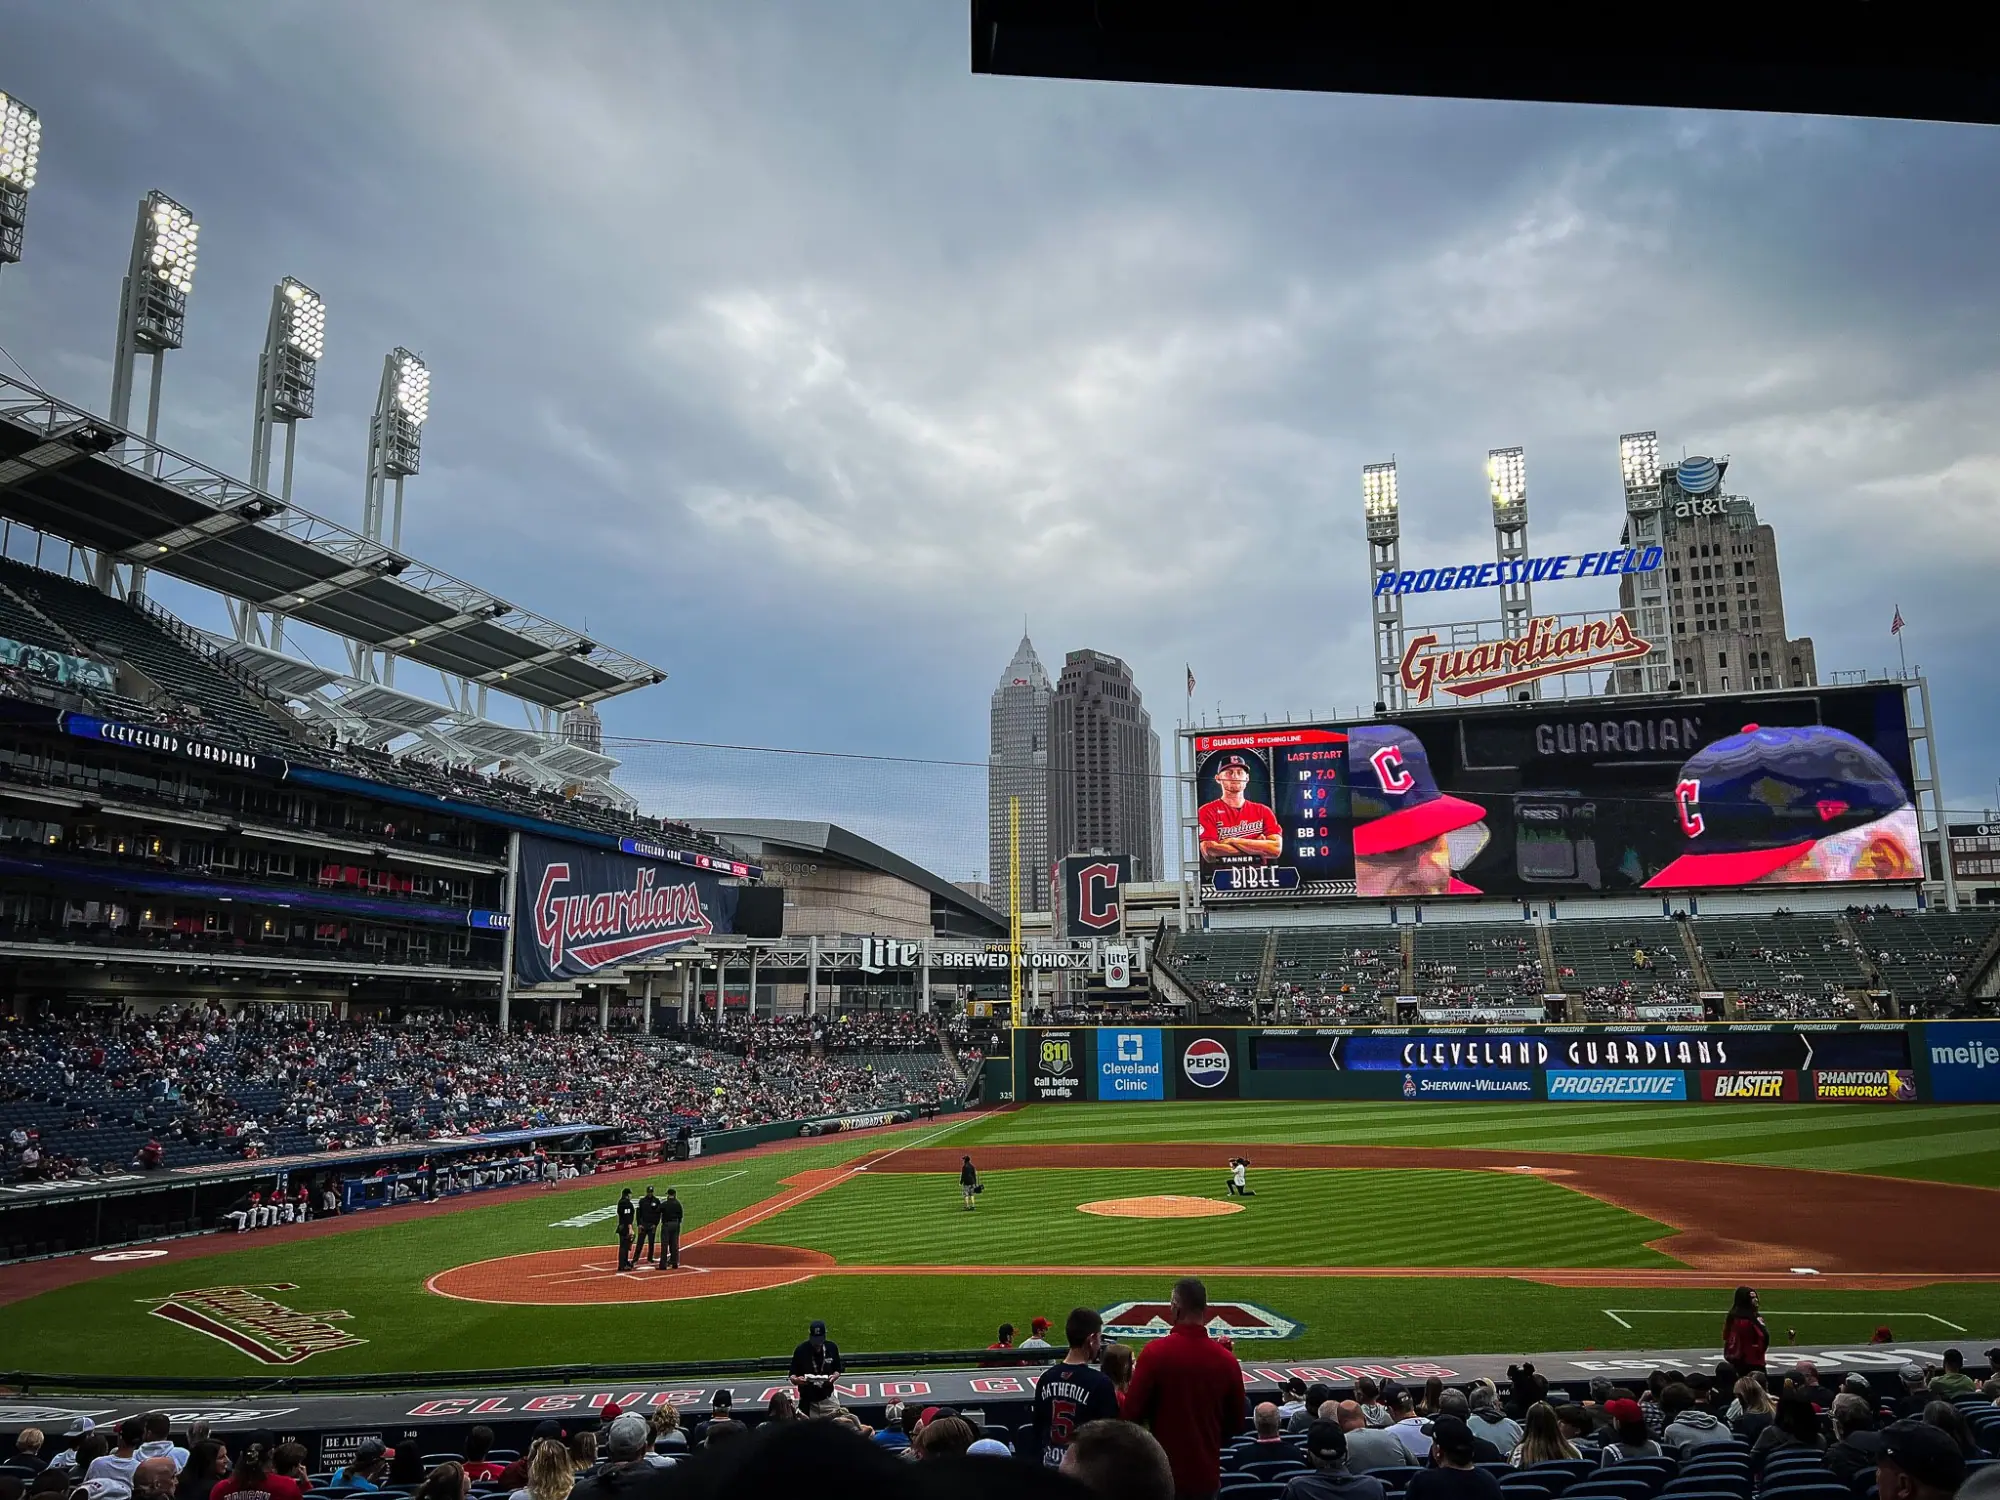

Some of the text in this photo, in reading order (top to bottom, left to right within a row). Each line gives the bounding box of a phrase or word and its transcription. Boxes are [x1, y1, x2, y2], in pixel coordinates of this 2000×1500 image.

[1675, 493, 1729, 518] at&t
[1374, 546, 1664, 597] PROGRESSIVE FIELD
[1400, 613, 1642, 705] Guardians
[102, 723, 257, 770] CLEVELAND GUARDIANS
[1213, 737, 1254, 747] GUARDIANS
[1257, 736, 1287, 744] PITCHING
[1287, 735, 1301, 743] LINE
[1287, 750, 1343, 762] LAST START
[1299, 769, 1336, 781] IP 7.0
[1303, 790, 1313, 800] K
[1304, 808, 1327, 819] H 2
[1297, 827, 1328, 838] BB 0
[1299, 846, 1329, 857] ER 0
[1230, 865, 1280, 889] BIBEE
[1078, 862, 1120, 929] C
[534, 862, 705, 973] Guardians
[858, 935, 922, 975] Lite
[943, 953, 1008, 968] BREWED
[1032, 953, 1068, 968] OHIO
[1107, 952, 1127, 966] Lite
[1793, 1023, 1837, 1031] PROGRESSIVE
[1043, 1042, 1069, 1062] 811
[1404, 1040, 1727, 1065] CLEVELAND GUARDIANS
[1102, 1062, 1159, 1075] Cleveland
[1187, 1058, 1227, 1068] PEPSI
[1034, 1076, 1079, 1087] Call before
[1115, 1079, 1148, 1091] Clinic
[1551, 1075, 1676, 1094] PROGRESSIVE
[1818, 1071, 1888, 1085] PHANTOM
[1715, 1075, 1783, 1097] BLASTER
[1818, 1085, 1888, 1098] FIREWORKS
[1000, 1091, 1013, 1100] 325
[1041, 1088, 1056, 1099] you
[851, 1115, 884, 1130] CONRAD'S
[1567, 1357, 1714, 1371] EST.
[406, 1380, 931, 1417] CLEVELAND
[1050, 1399, 1077, 1445] 5
[325, 1437, 340, 1448] BE
